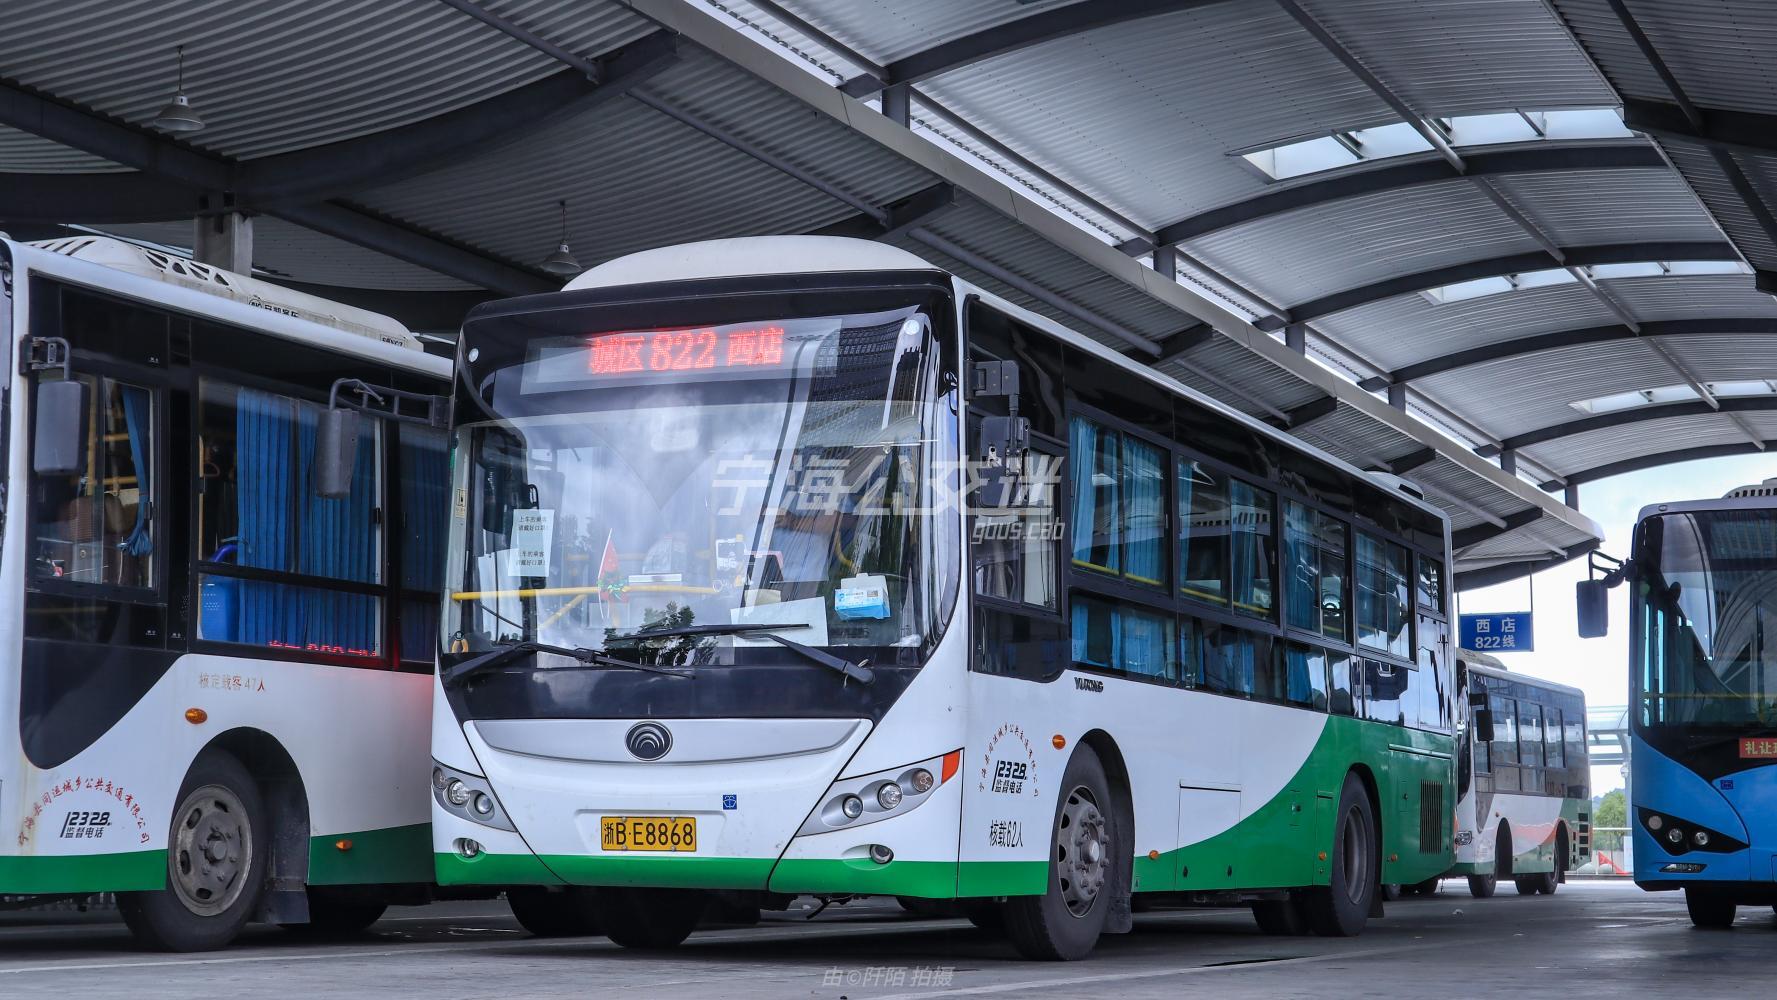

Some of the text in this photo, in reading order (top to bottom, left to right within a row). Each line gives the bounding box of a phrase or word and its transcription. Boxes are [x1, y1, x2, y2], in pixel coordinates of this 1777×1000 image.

[650, 331, 718, 371] 822
[727, 327, 785, 366] 西店
[1074, 677, 1104, 693] YUTONG
[995, 779, 1022, 794] 监督电话
[64, 826, 105, 838] 监督电话
[989, 819, 1024, 847] 核载62人
